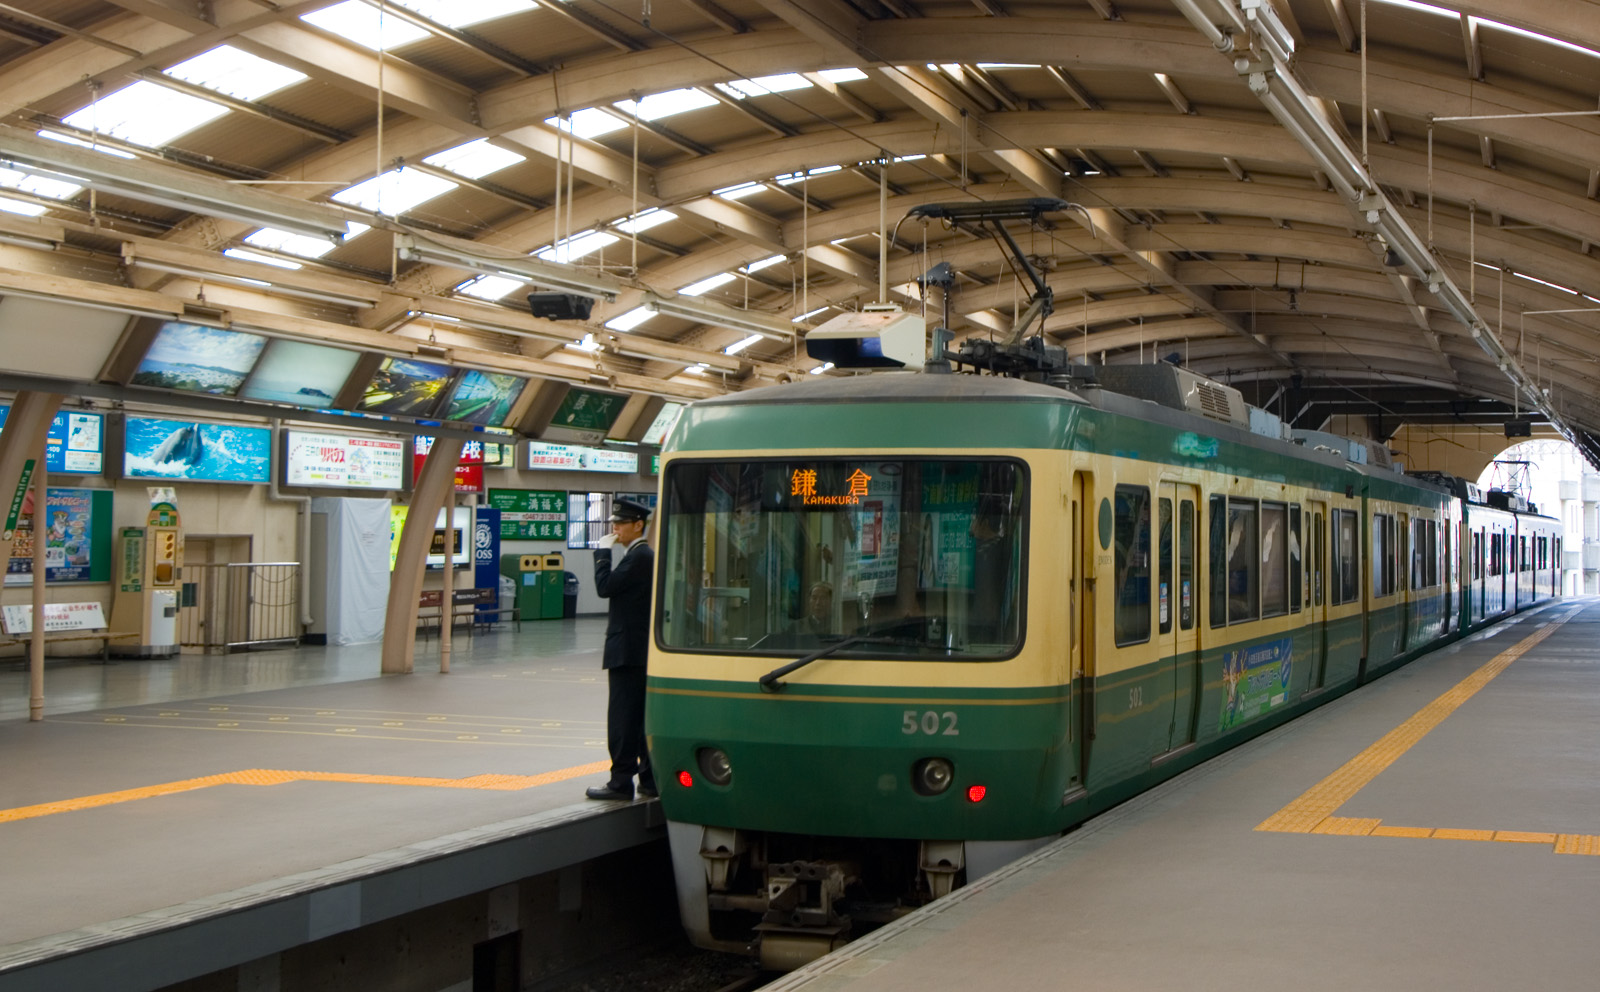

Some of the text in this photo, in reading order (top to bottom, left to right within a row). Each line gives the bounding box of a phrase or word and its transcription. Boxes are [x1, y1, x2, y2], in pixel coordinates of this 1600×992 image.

[10, 470, 31, 518] Fujisawa
[791, 468, 872, 496] 鎌倉
[528, 498, 564, 511] 満福寺
[803, 496, 860, 505] KAMAKURA
[475, 549, 493, 559] OSS
[1128, 685, 1143, 710] 502
[901, 710, 960, 736] 502
